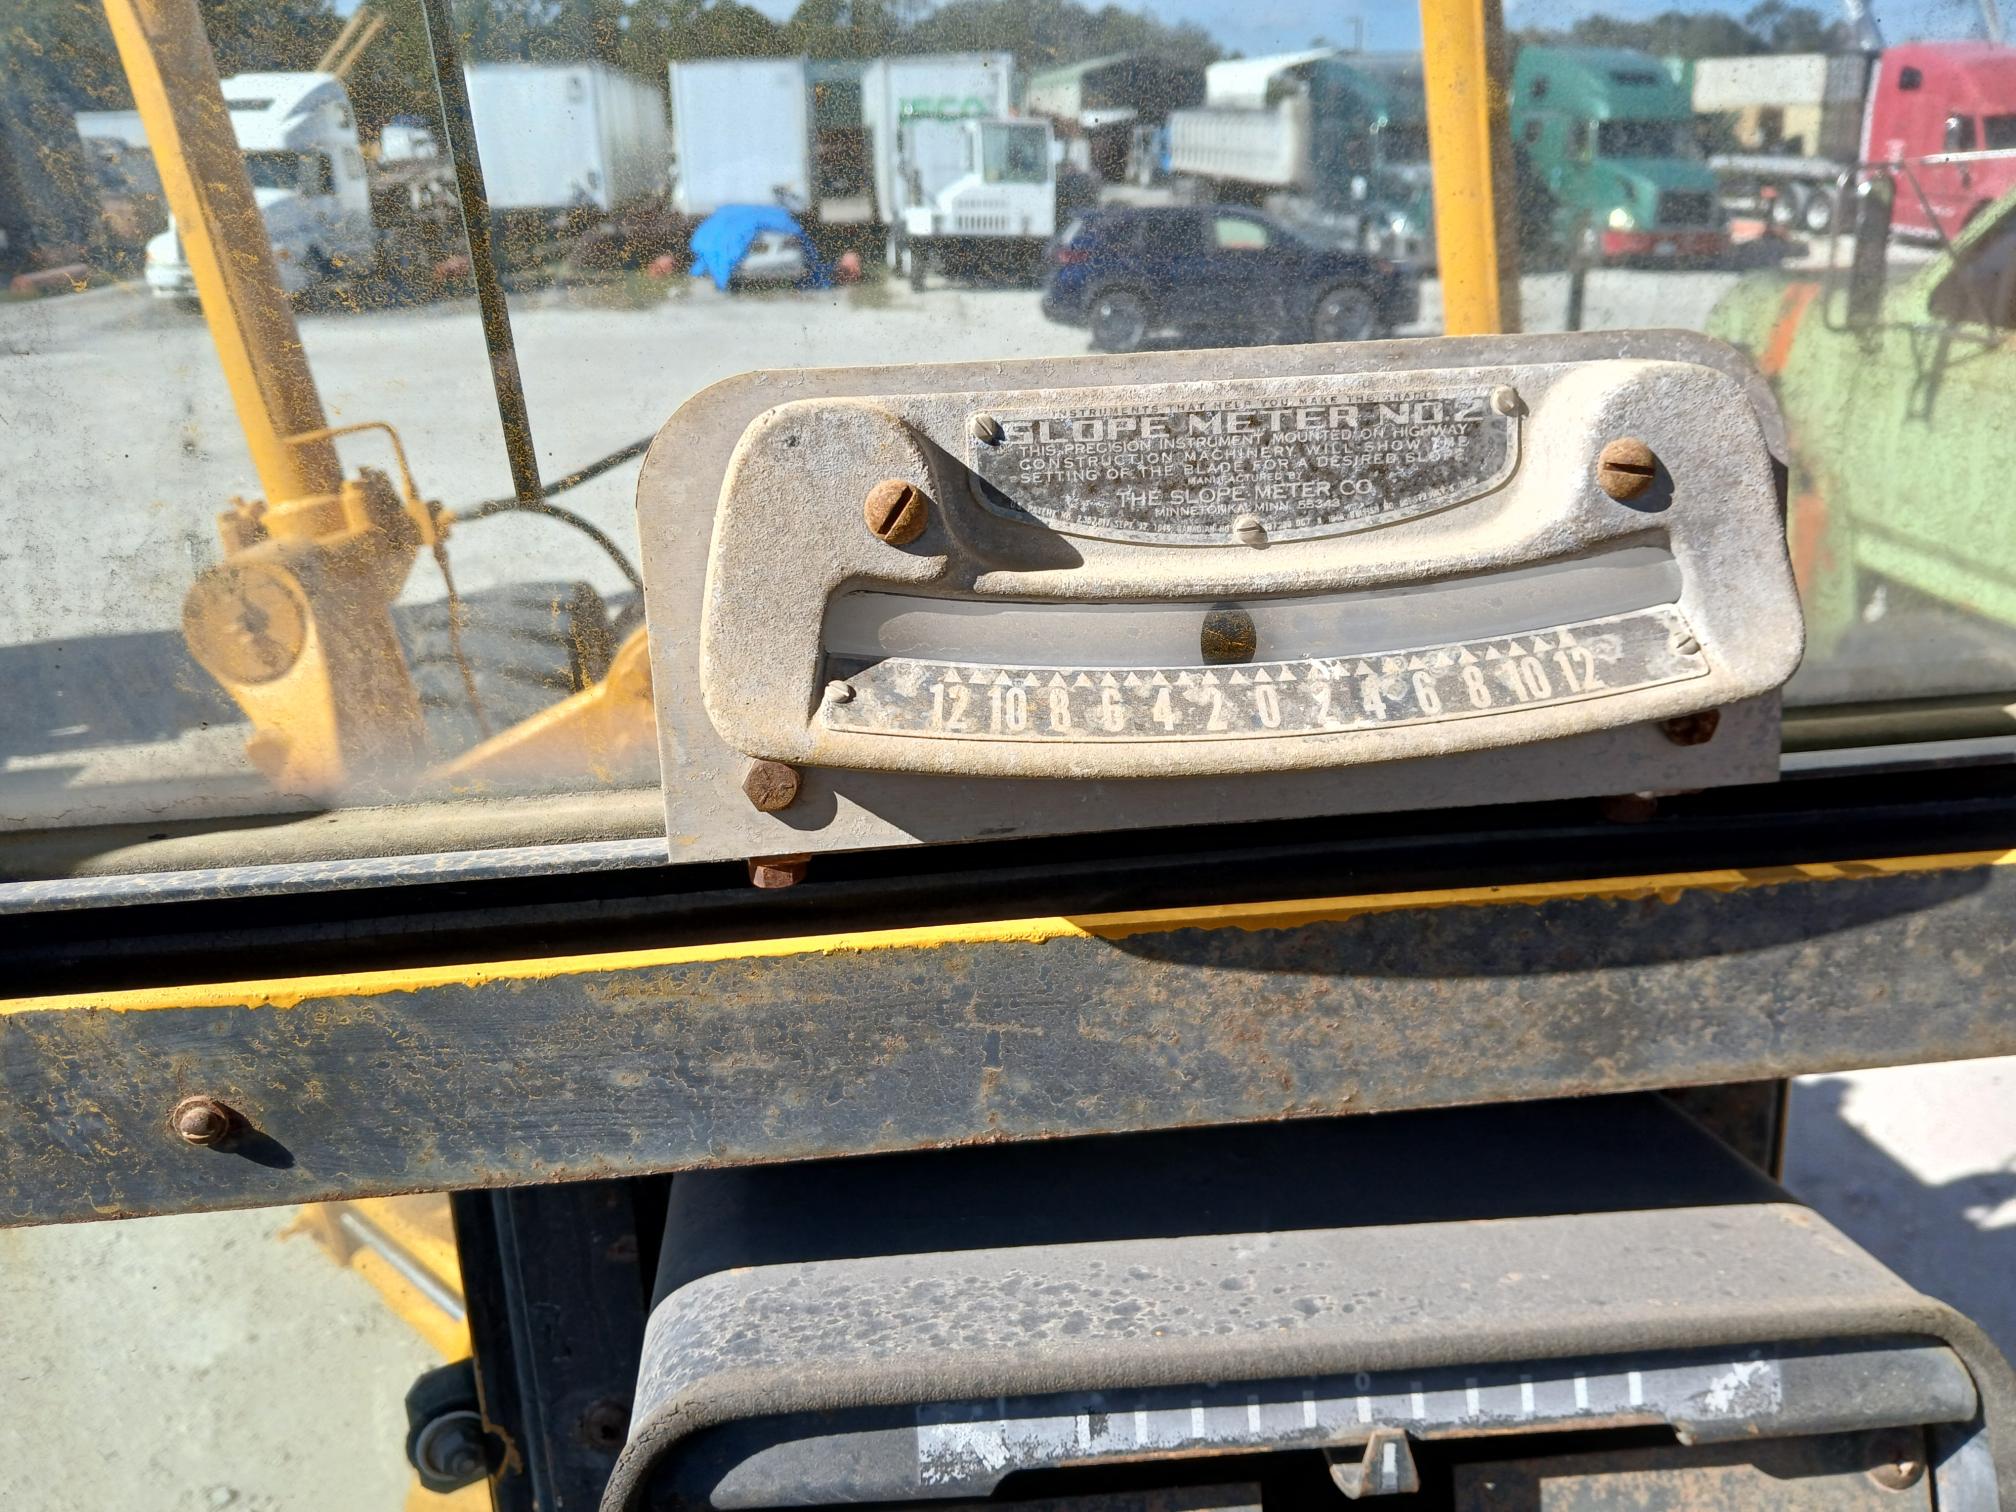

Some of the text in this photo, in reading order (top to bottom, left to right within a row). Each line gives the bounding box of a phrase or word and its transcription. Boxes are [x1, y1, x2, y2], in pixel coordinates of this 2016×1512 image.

[1168, 402, 1205, 412] THAT
[1260, 398, 1289, 407] YOU
[1299, 395, 1338, 405] MAKE
[1002, 416, 1171, 444] SLOPE
[1189, 405, 1359, 436] METER
[1020, 423, 1469, 457] THIS PRECISION INSTRUMENT MOUNTED ON HIGHWAY
[1019, 469, 1099, 484] SETTING
[1106, 466, 1130, 480] OF
[1140, 463, 1175, 478] THE
[1184, 460, 1246, 476] BLADE
[1253, 458, 1288, 471] FOR
[1297, 457, 1309, 469] A
[1316, 452, 1397, 468] DESIRED
[1020, 451, 1174, 471] CONSTRUCTION
[1184, 445, 1295, 462] MACHINERY
[1305, 441, 1353, 455] WILL
[1364, 438, 1420, 452] SHOW
[1187, 470, 1304, 486] MANUFACTURED BY
[1116, 488, 1163, 511] THE
[1170, 485, 1247, 505] SLOPE
[1254, 480, 1331, 501] METER
[929, 682, 967, 728] 12
[989, 685, 1027, 730] 10
[1047, 686, 1072, 731] 8
[1102, 686, 1125, 732] 6
[1152, 686, 1175, 731] 4
[1204, 686, 1229, 731] 2
[1256, 684, 1282, 728] 0
[1361, 675, 1388, 720] 4
[1412, 671, 1442, 715] 6
[1462, 665, 1493, 709] 8
[1502, 656, 1552, 702] 10
[1552, 646, 1606, 693] 12
